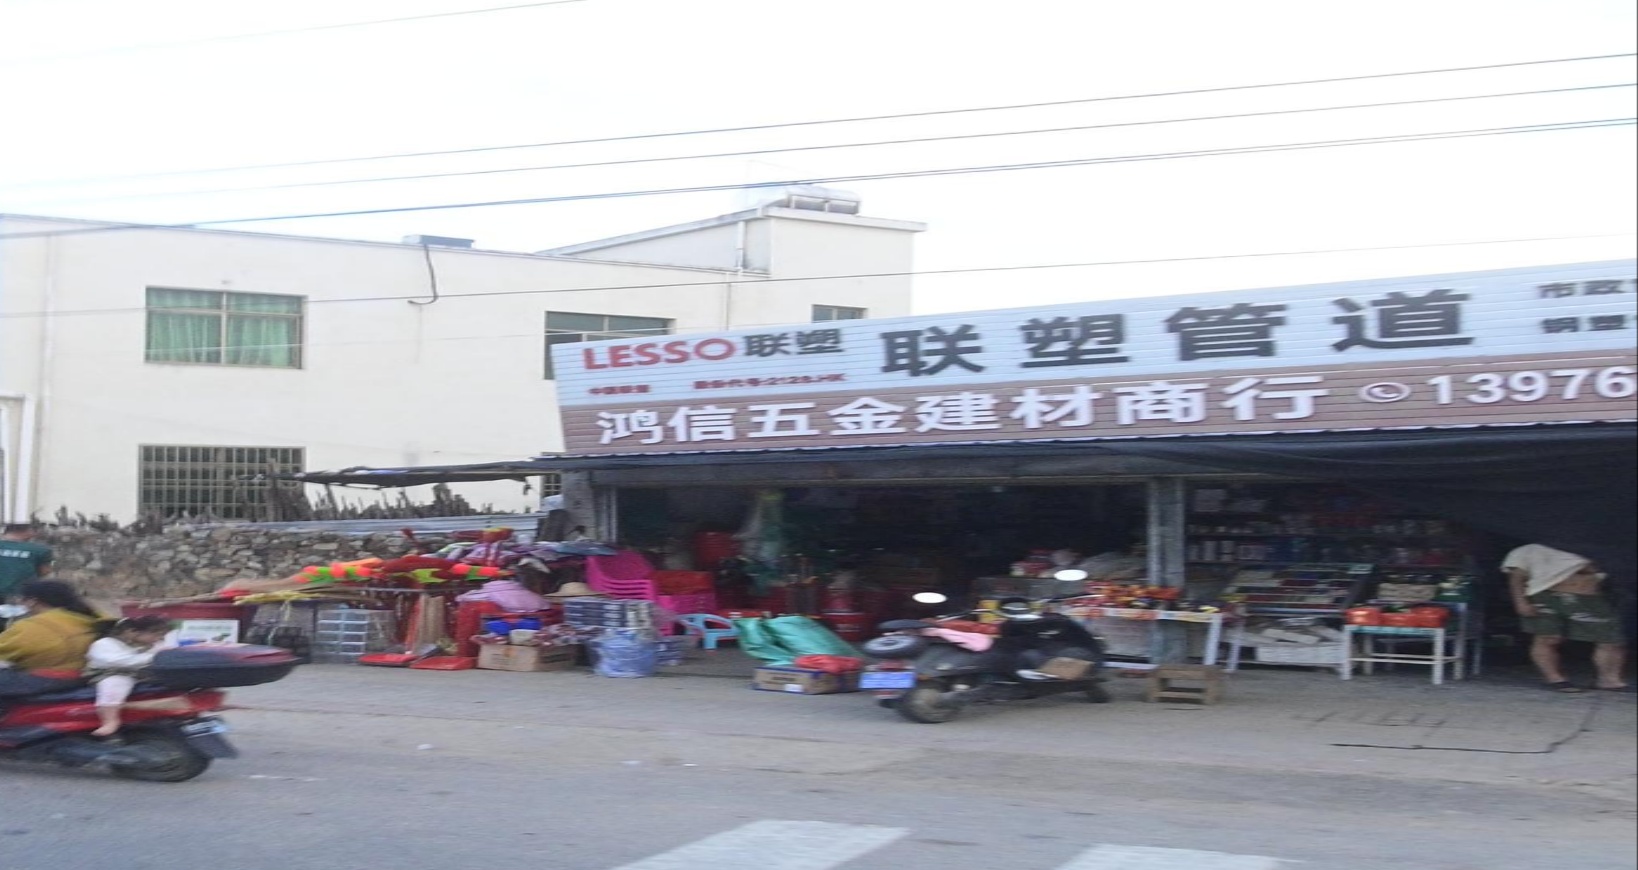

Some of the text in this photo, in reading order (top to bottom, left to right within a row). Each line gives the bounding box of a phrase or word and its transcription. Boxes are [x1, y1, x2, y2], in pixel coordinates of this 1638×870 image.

[1538, 278, 1637, 298] 市政
[880, 289, 1475, 376] 联塑管道
[1541, 314, 1637, 334] 钢塑
[583, 337, 736, 369] LESSO
[744, 328, 844, 357] 联塑
[1428, 366, 1637, 404] 13976
[597, 376, 1328, 444] 鸿信五金建材商行
